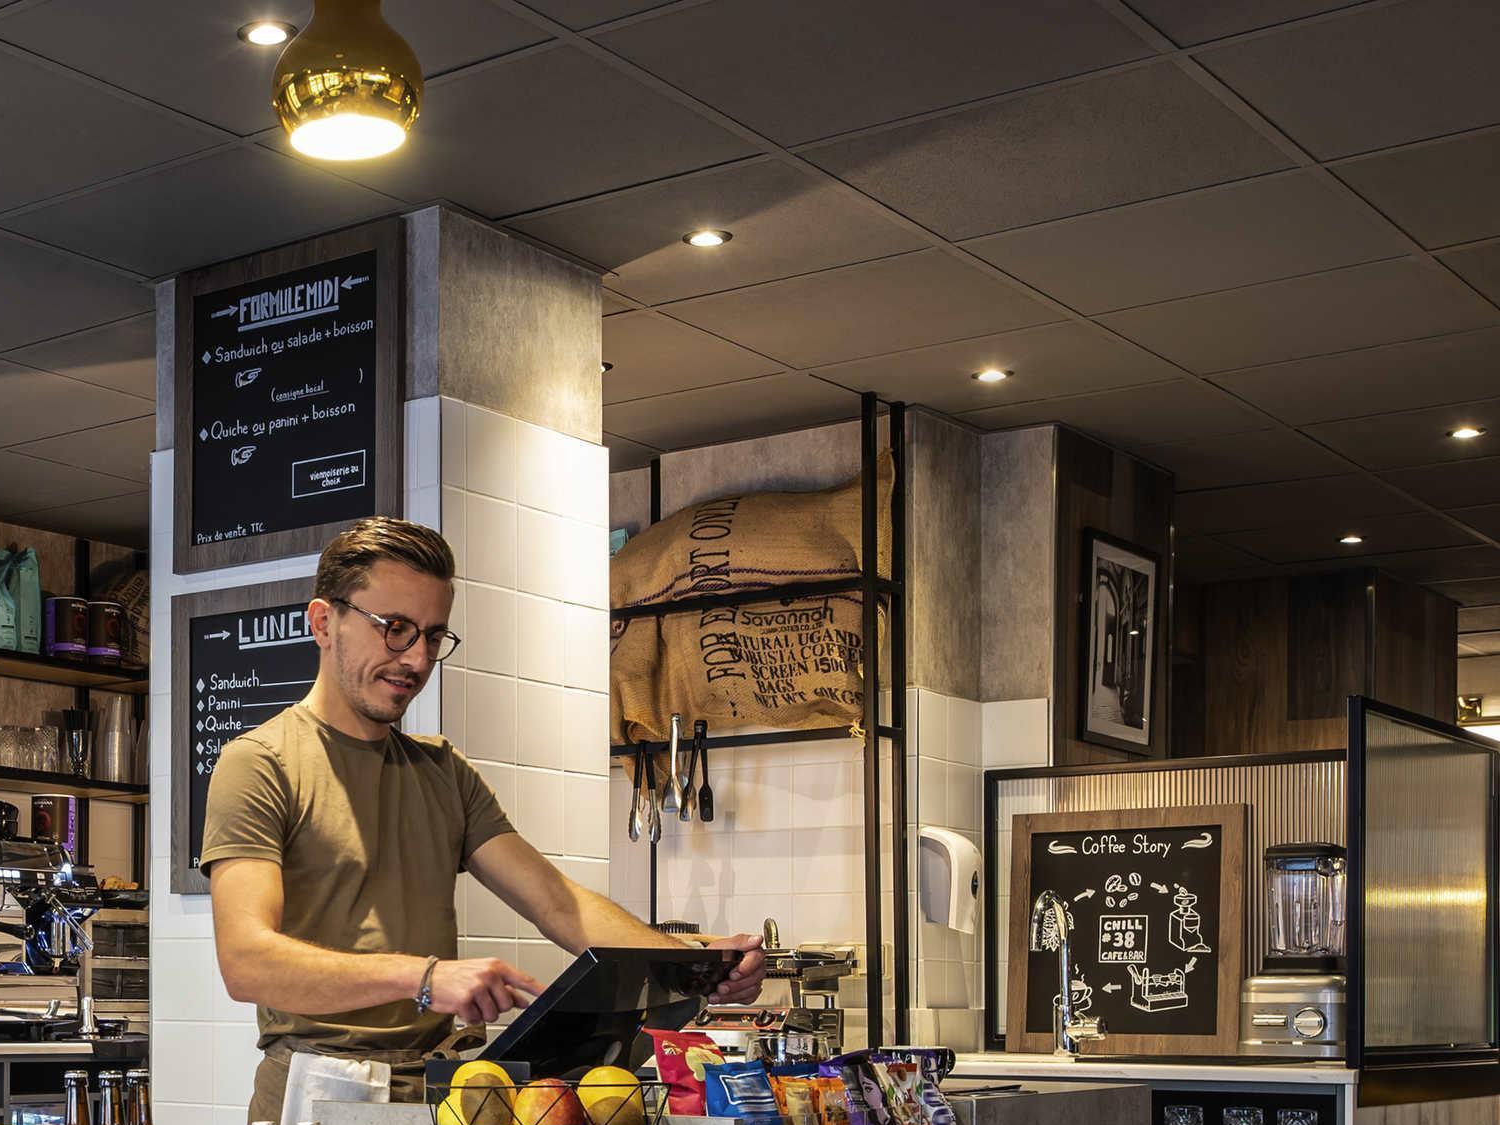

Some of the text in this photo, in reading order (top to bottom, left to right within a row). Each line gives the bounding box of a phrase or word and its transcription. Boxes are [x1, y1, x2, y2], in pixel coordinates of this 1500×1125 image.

[238, 276, 339, 324] FORMULE MIDI
[214, 340, 268, 364] Sandwich
[271, 338, 285, 354] ou
[287, 328, 323, 349] salade
[333, 318, 374, 337] boisson
[305, 379, 325, 394] bocal
[210, 419, 249, 441] Quiche
[252, 420, 266, 437] ou
[268, 413, 299, 436] panini
[312, 402, 356, 422] boisson
[309, 465, 359, 482] viennoiserie au
[321, 477, 341, 488] choix
[196, 522, 265, 545] Prix de vente TTC
[689, 496, 746, 683] FOR EORT ONL
[740, 599, 834, 627] Savannah
[798, 628, 863, 648] UGAND
[209, 669, 260, 692] Sandwich
[750, 661, 809, 681] SCREEN
[755, 678, 796, 695] BAGS
[208, 694, 241, 712] Panini
[752, 690, 779, 709] NET
[205, 714, 242, 732] Quiche
[1081, 833, 1172, 859] Coffee Story
[1103, 919, 1143, 931] CHILL
